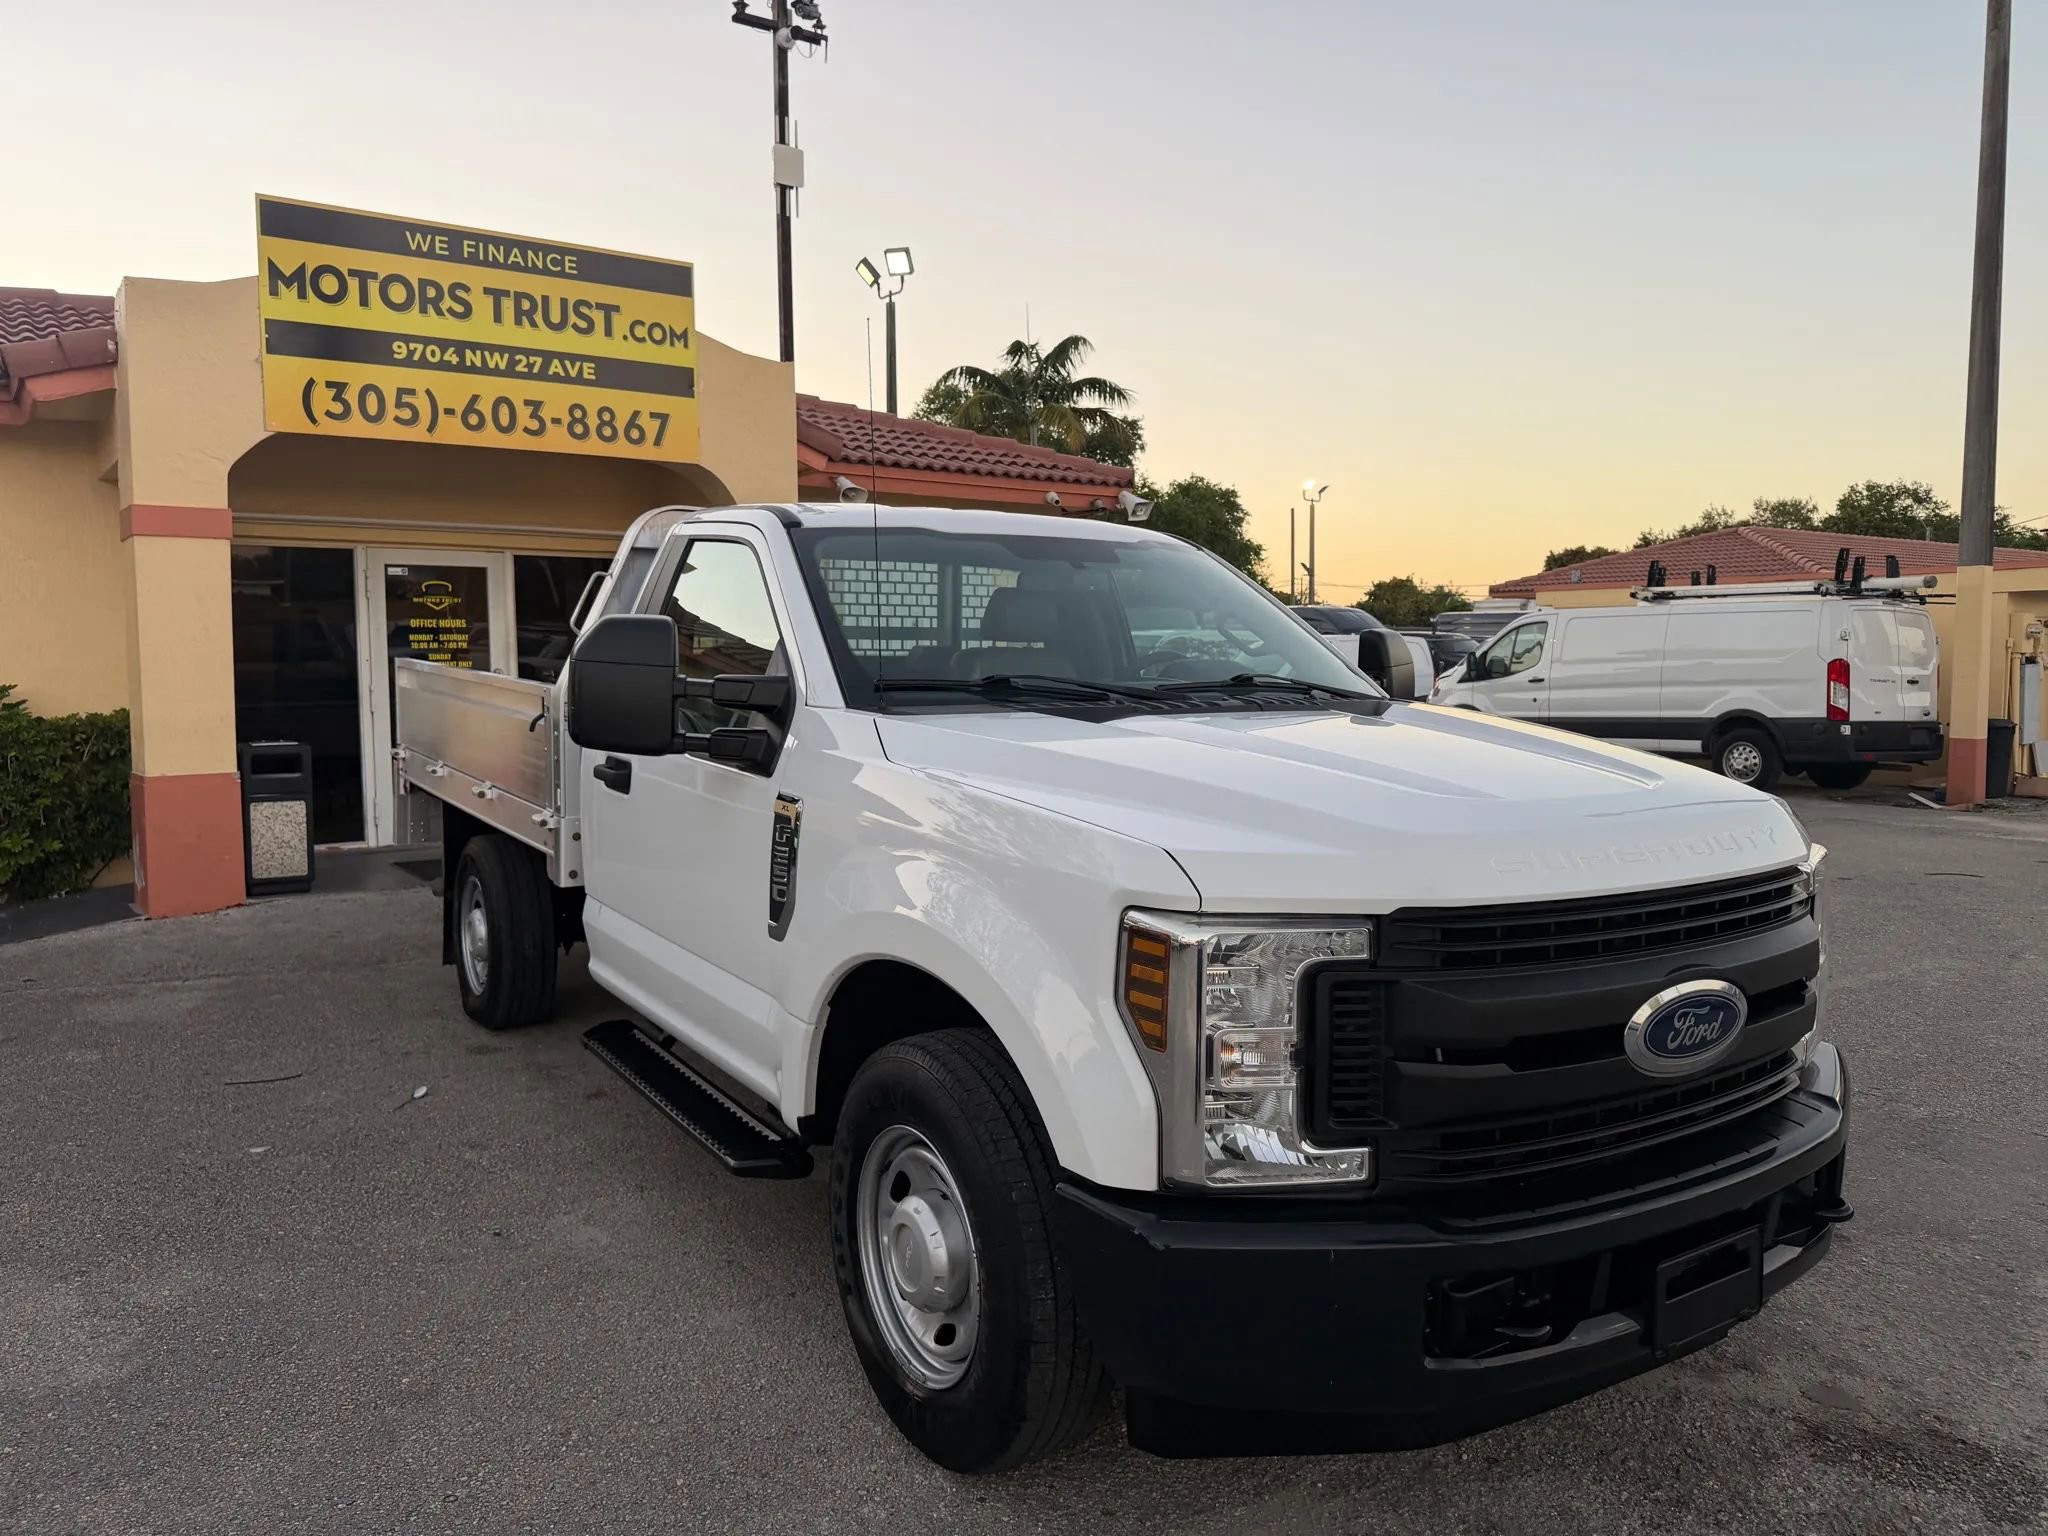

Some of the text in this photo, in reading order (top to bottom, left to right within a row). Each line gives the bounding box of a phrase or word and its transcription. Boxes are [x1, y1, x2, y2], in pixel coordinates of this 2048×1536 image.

[405, 231, 579, 274] WE FINANCE
[267, 256, 473, 322] MOTORS
[392, 341, 596, 380] 9704 NW 27 AVE
[302, 377, 671, 448] (305)-603-8867
[410, 619, 467, 628] OFFICE HOURS
[1667, 1005, 1724, 1050] Ford
